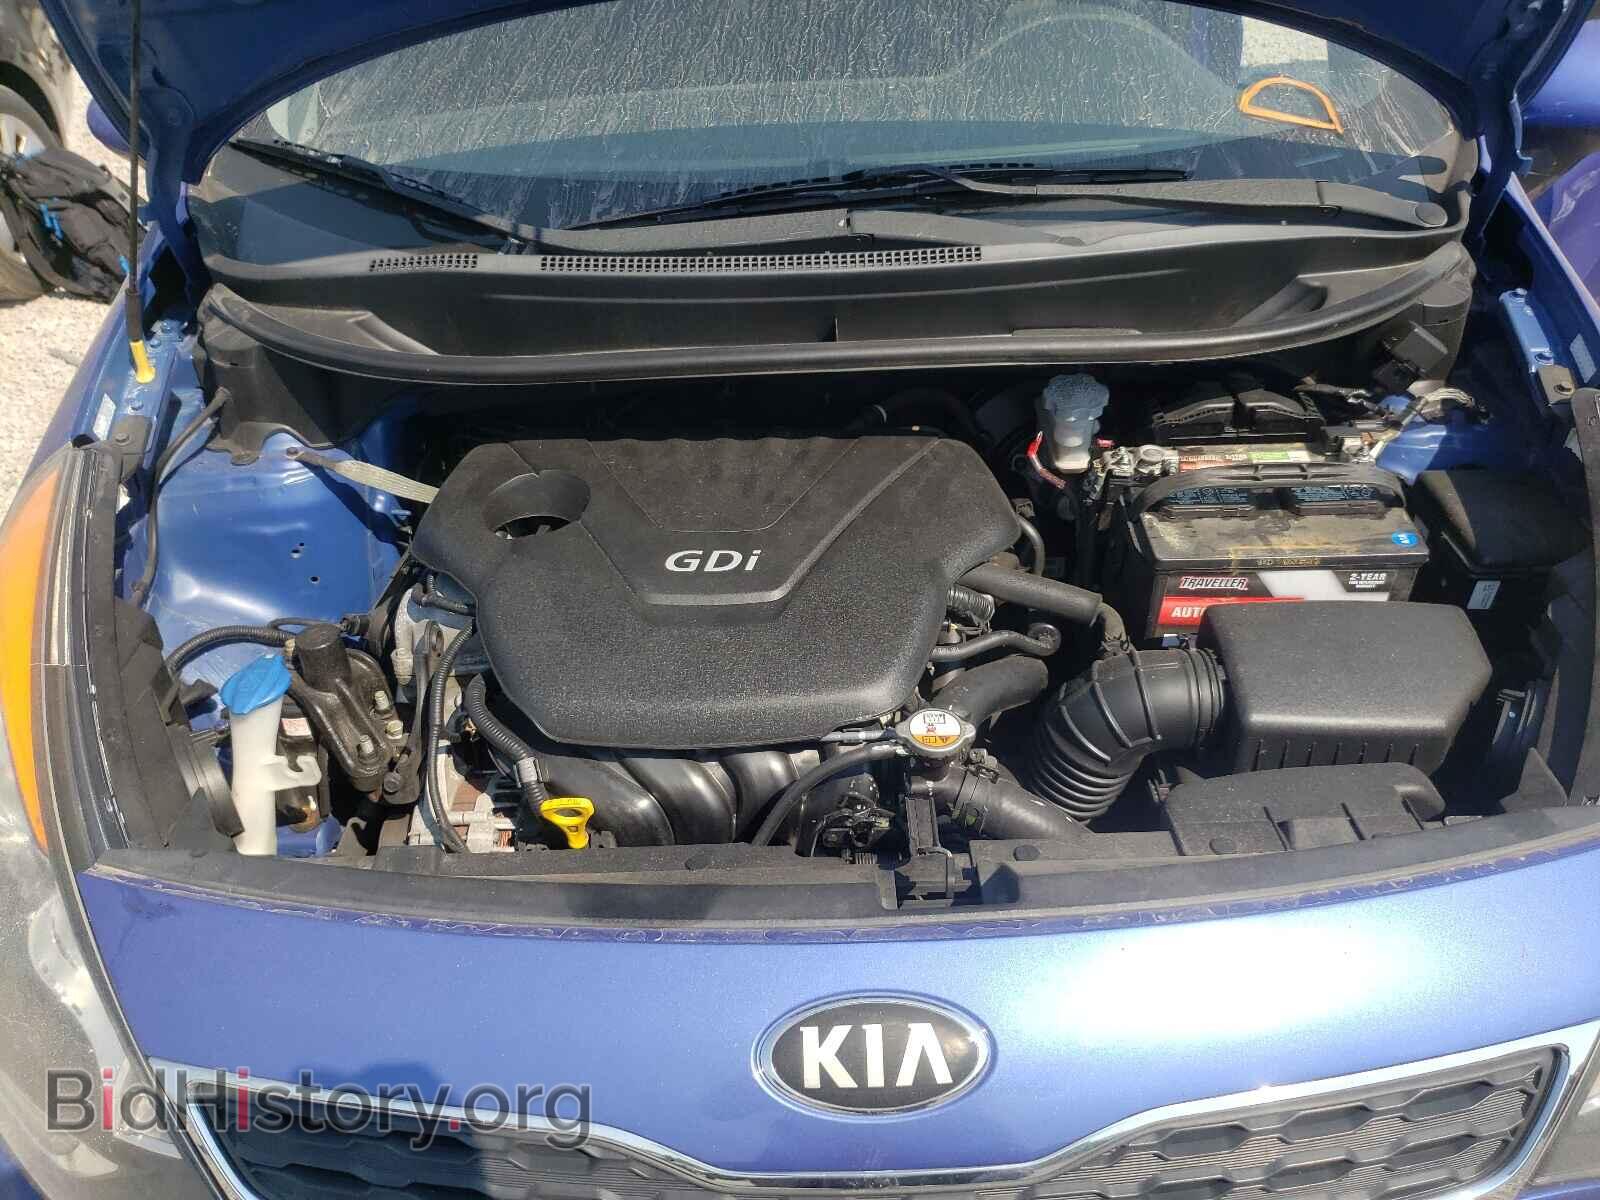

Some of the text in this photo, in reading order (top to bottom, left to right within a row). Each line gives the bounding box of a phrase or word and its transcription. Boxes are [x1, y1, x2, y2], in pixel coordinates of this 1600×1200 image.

[664, 549, 762, 572] GDi
[1179, 576, 1248, 590] TRAVELLER
[800, 1022, 954, 1089] KIA
